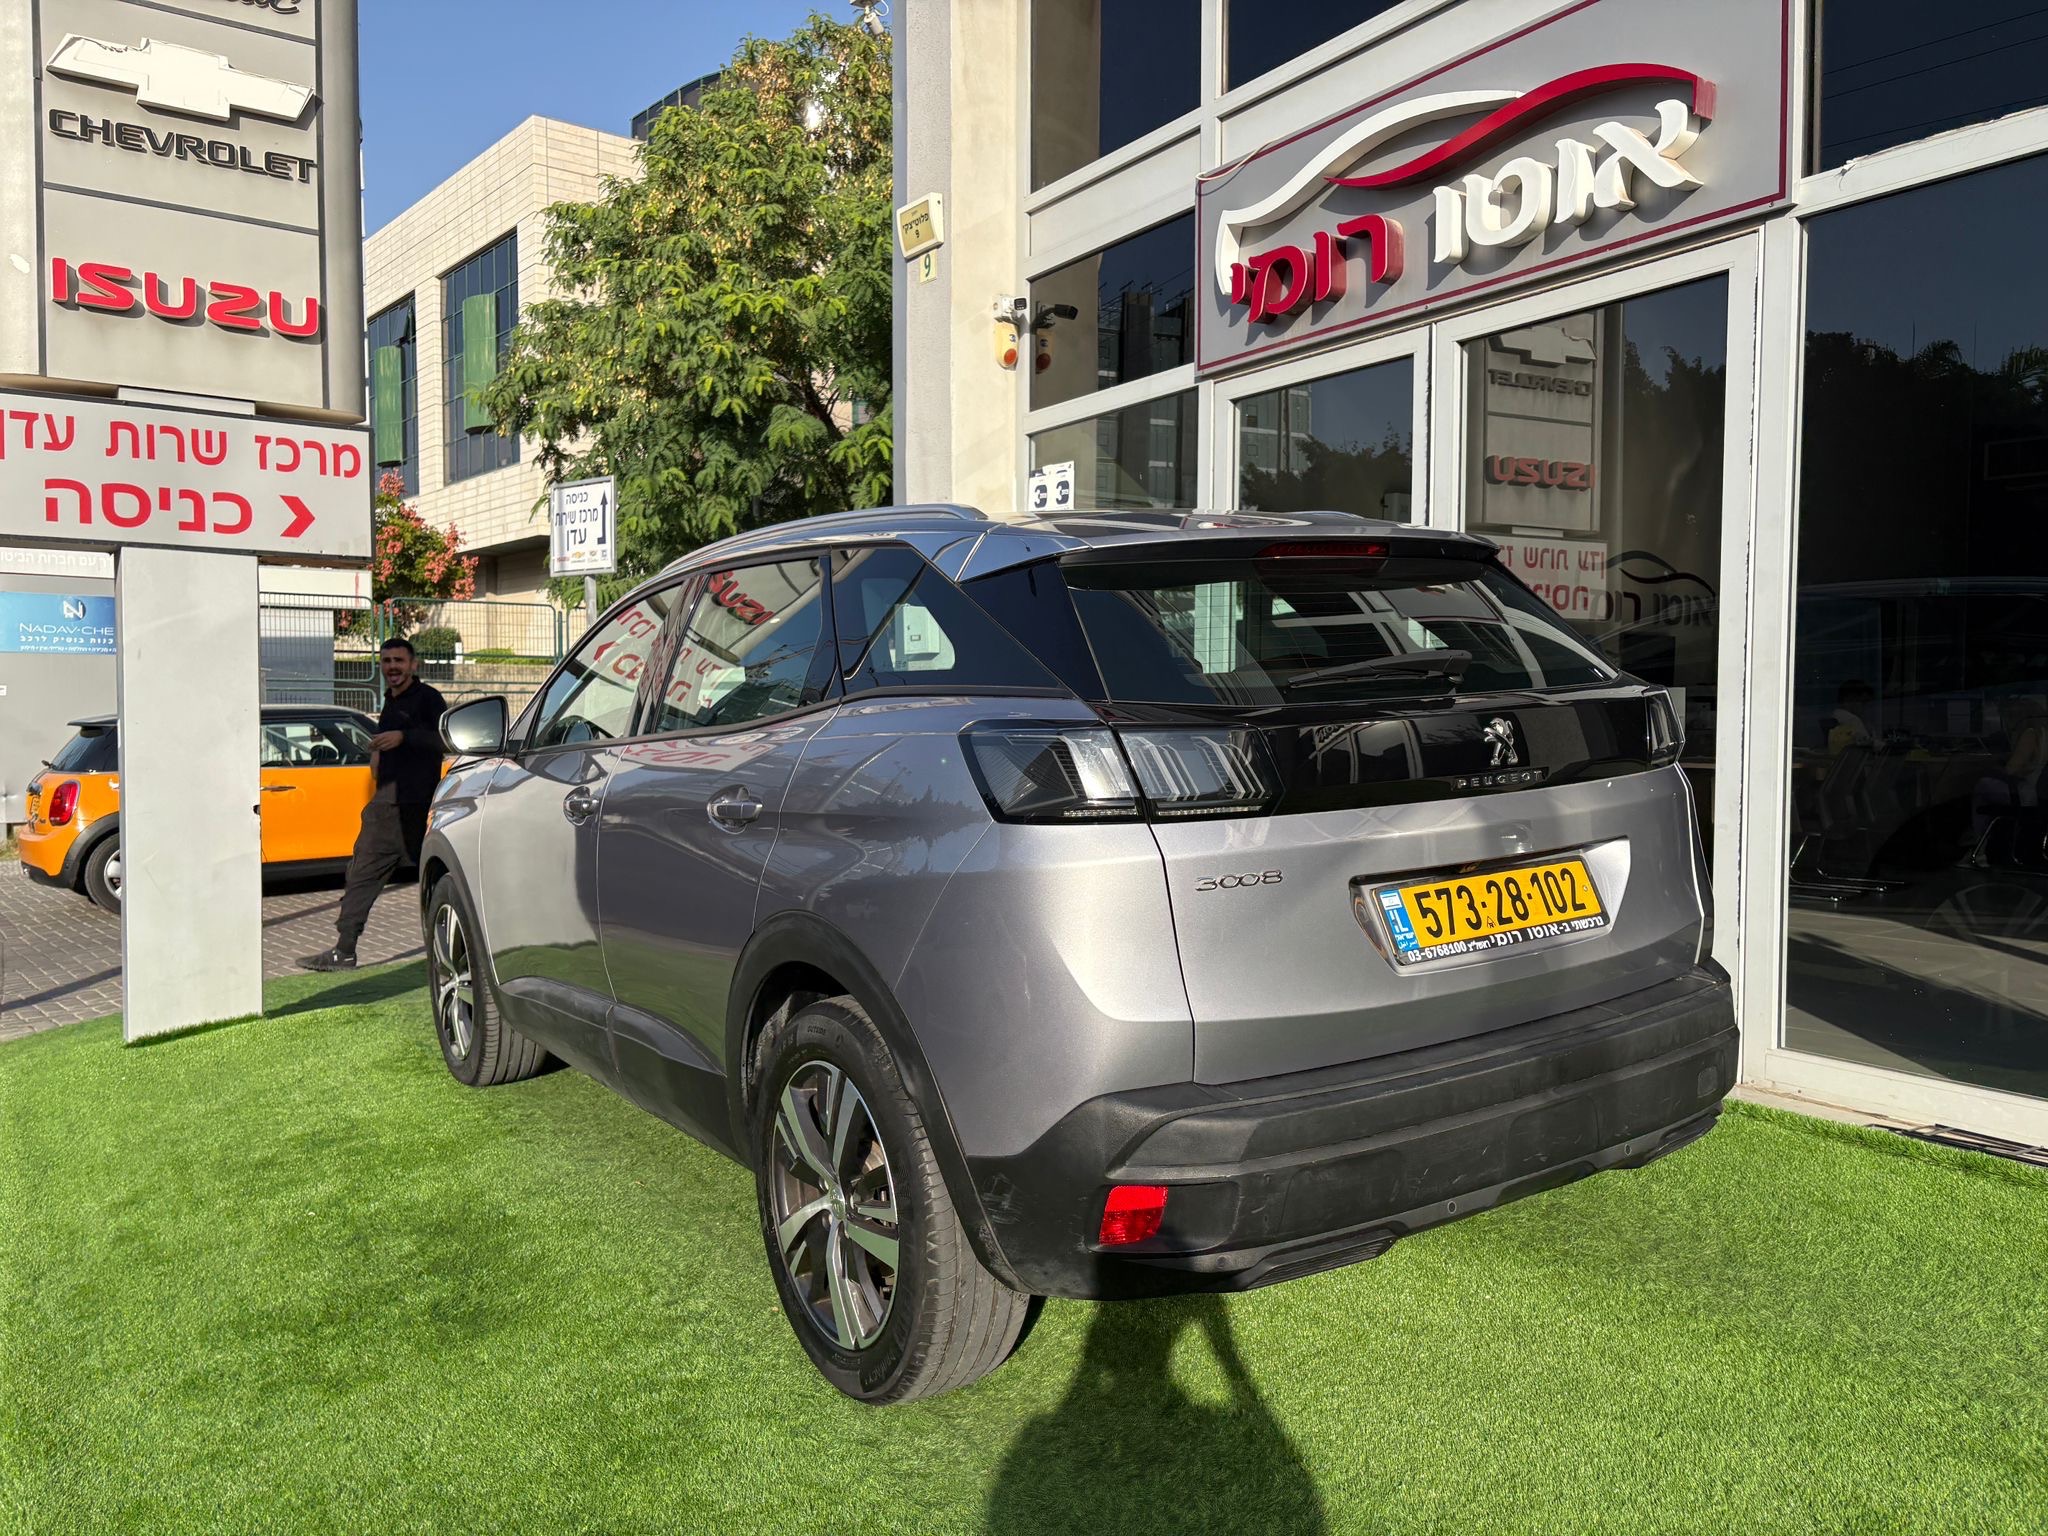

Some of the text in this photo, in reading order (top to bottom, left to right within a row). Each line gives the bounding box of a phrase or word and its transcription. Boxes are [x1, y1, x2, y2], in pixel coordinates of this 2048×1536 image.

[49, 109, 316, 182] CHEVROLET
[1231, 99, 1704, 324] אוטו רומי
[924, 253, 931, 278] 9
[51, 257, 319, 337] ISUZU
[105, 420, 228, 467] שרות
[255, 434, 362, 479] מרכז
[44, 478, 254, 535] כניסה
[566, 491, 588, 505] כניסה
[579, 508, 598, 523] מרכז
[566, 528, 587, 551] עדן
[1457, 770, 1543, 789] PEUGEOT
[1195, 869, 1283, 891] 3008
[1389, 909, 1409, 933] IL
[1571, 915, 1604, 930] נרכשתי
[1490, 926, 1523, 946] רומי
[1407, 939, 1467, 962] 03-6768100
